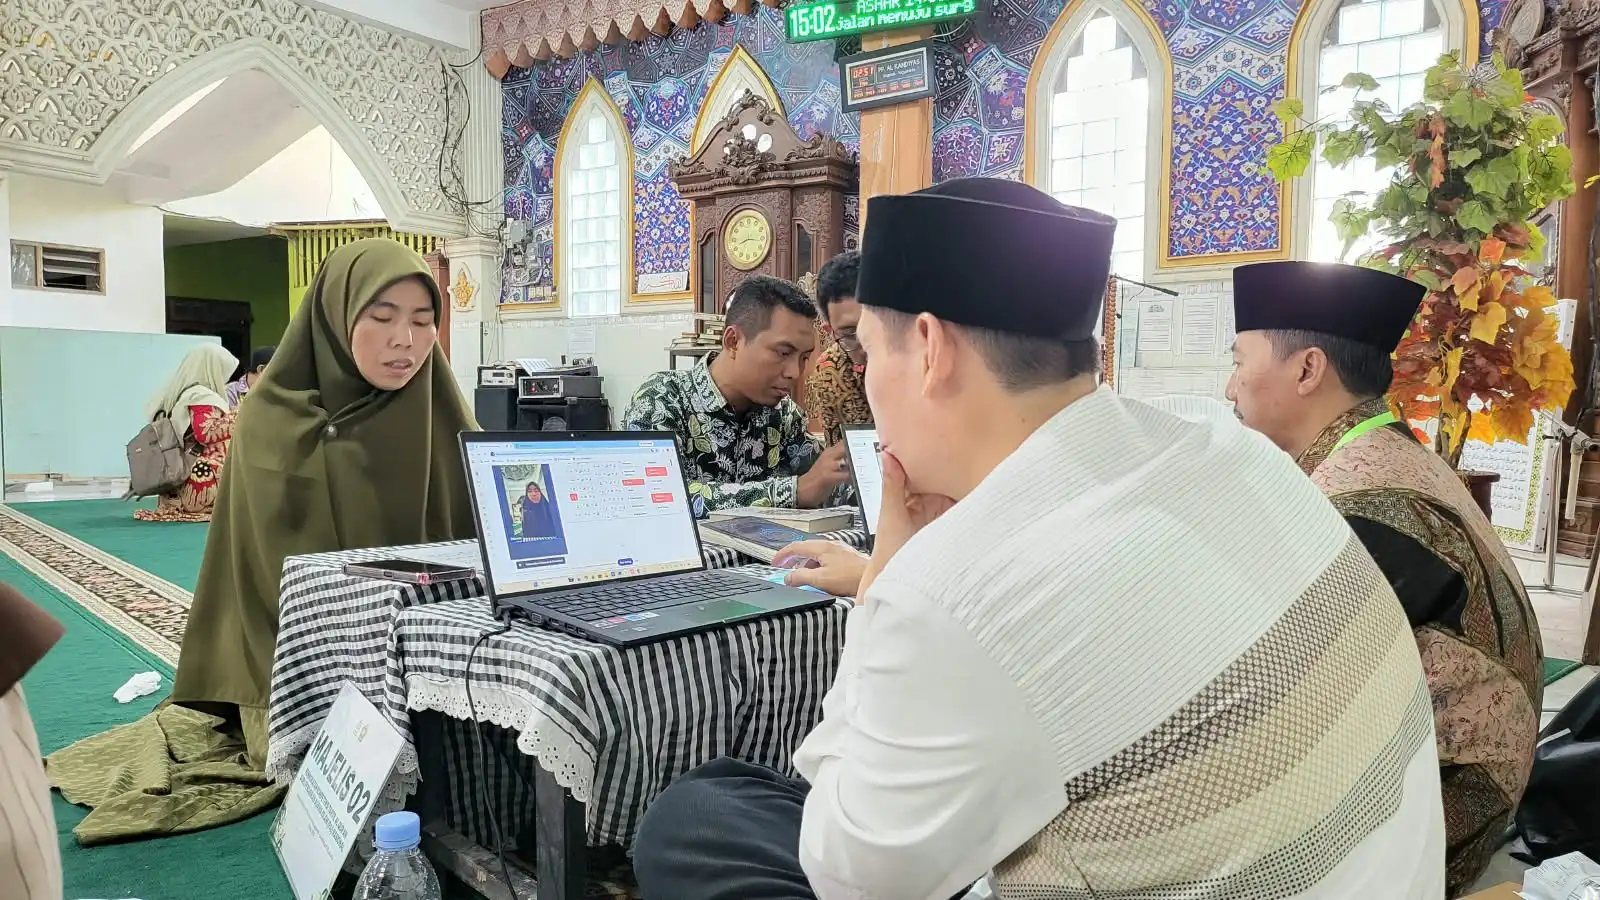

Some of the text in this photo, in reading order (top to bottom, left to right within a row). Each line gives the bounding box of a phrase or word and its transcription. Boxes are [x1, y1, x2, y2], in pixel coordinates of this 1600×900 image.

[789, 4, 836, 37] 15:02
[310, 729, 356, 802] MAJELIS
[346, 781, 371, 825] 02
